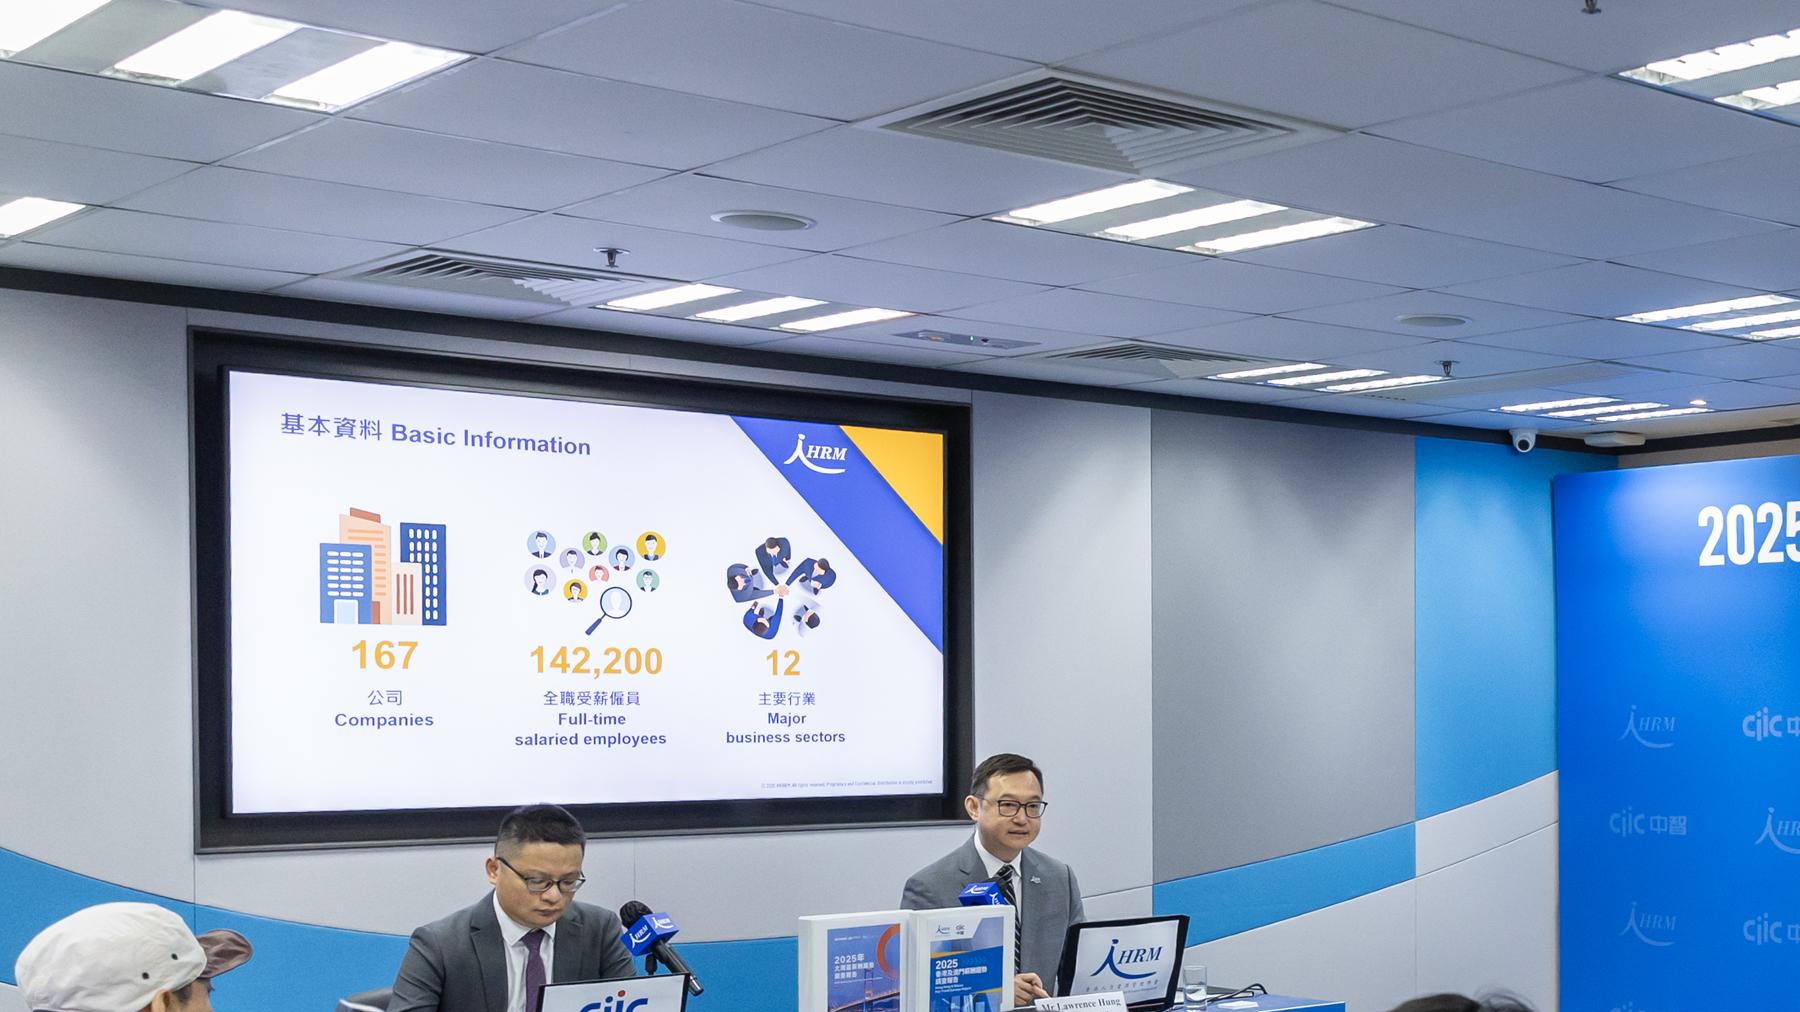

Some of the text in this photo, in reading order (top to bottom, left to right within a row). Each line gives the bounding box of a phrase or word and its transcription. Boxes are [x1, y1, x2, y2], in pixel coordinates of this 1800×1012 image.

[281, 412, 591, 456] 基本資料 Basic Information
[351, 639, 419, 670] 167
[530, 645, 663, 680] 142,200
[766, 649, 801, 676] 12
[367, 690, 403, 706] 公司
[543, 691, 641, 707] 全職受薪僱員
[758, 691, 817, 707] 主要行業
[334, 713, 435, 729] Companies
[558, 713, 627, 726] Full-time
[767, 712, 807, 727] Major
[515, 732, 667, 748] salaried employees
[726, 731, 846, 744] business sectors
[1649, 814, 1688, 837] 中智
[936, 959, 958, 969] 2025
[1057, 1001, 1097, 1011] Lawrence
[1098, 998, 1122, 1007] Hung
